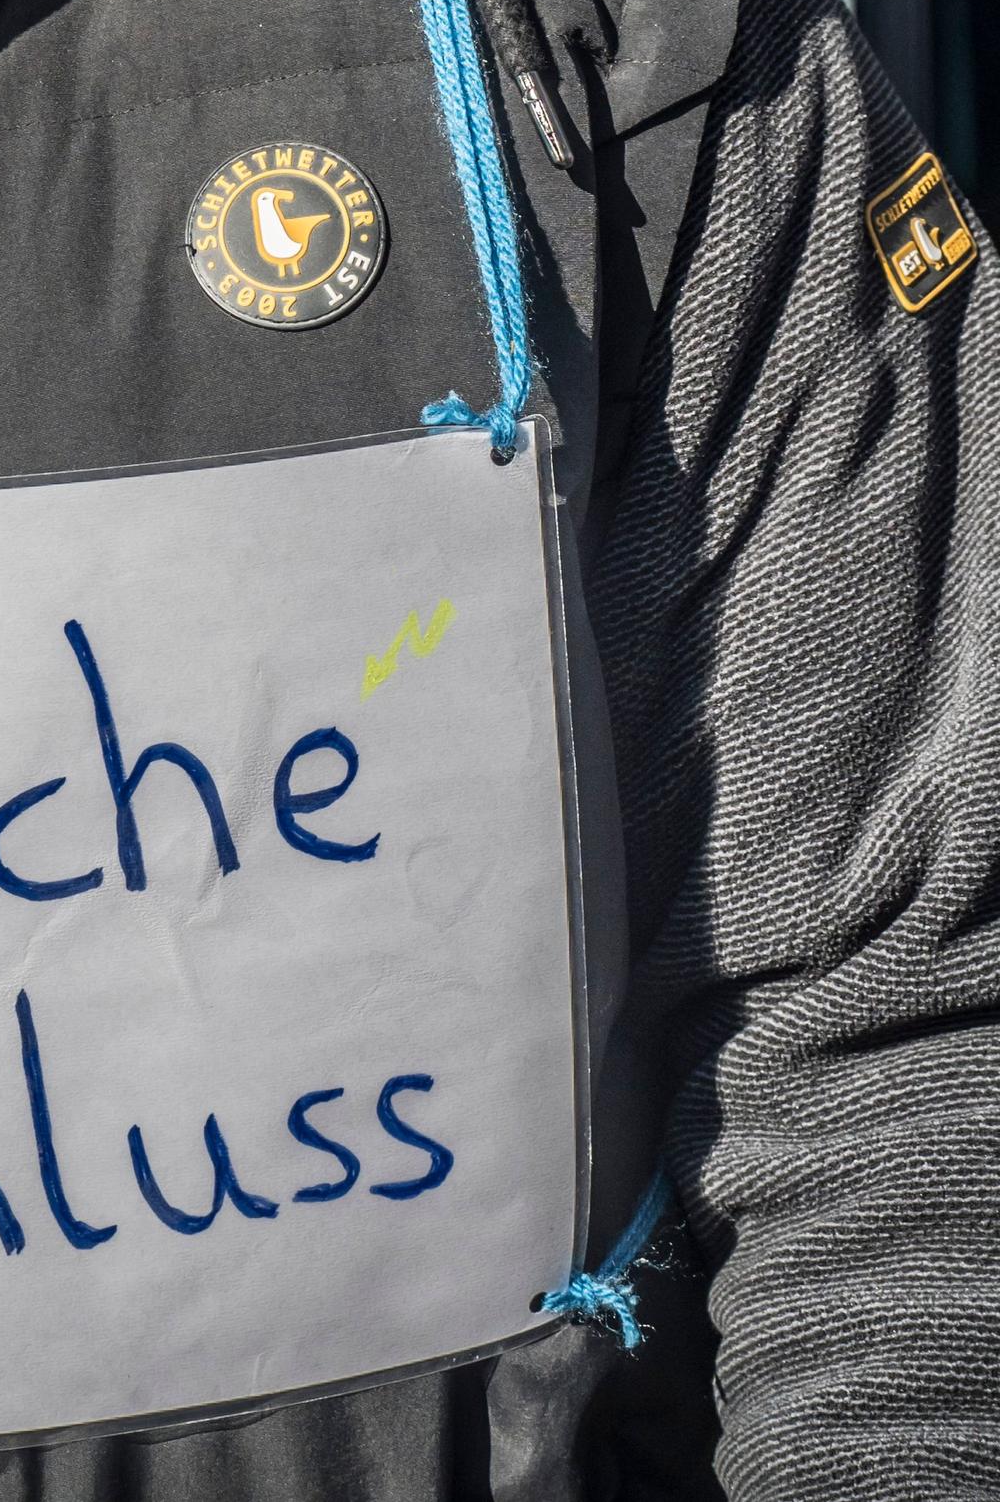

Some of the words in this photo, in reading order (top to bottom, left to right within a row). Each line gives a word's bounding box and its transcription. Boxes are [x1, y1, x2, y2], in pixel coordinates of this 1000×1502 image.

[197, 148, 374, 250] SCHIETWETTER
[219, 274, 297, 317] 2003
[324, 252, 371, 306] EST
